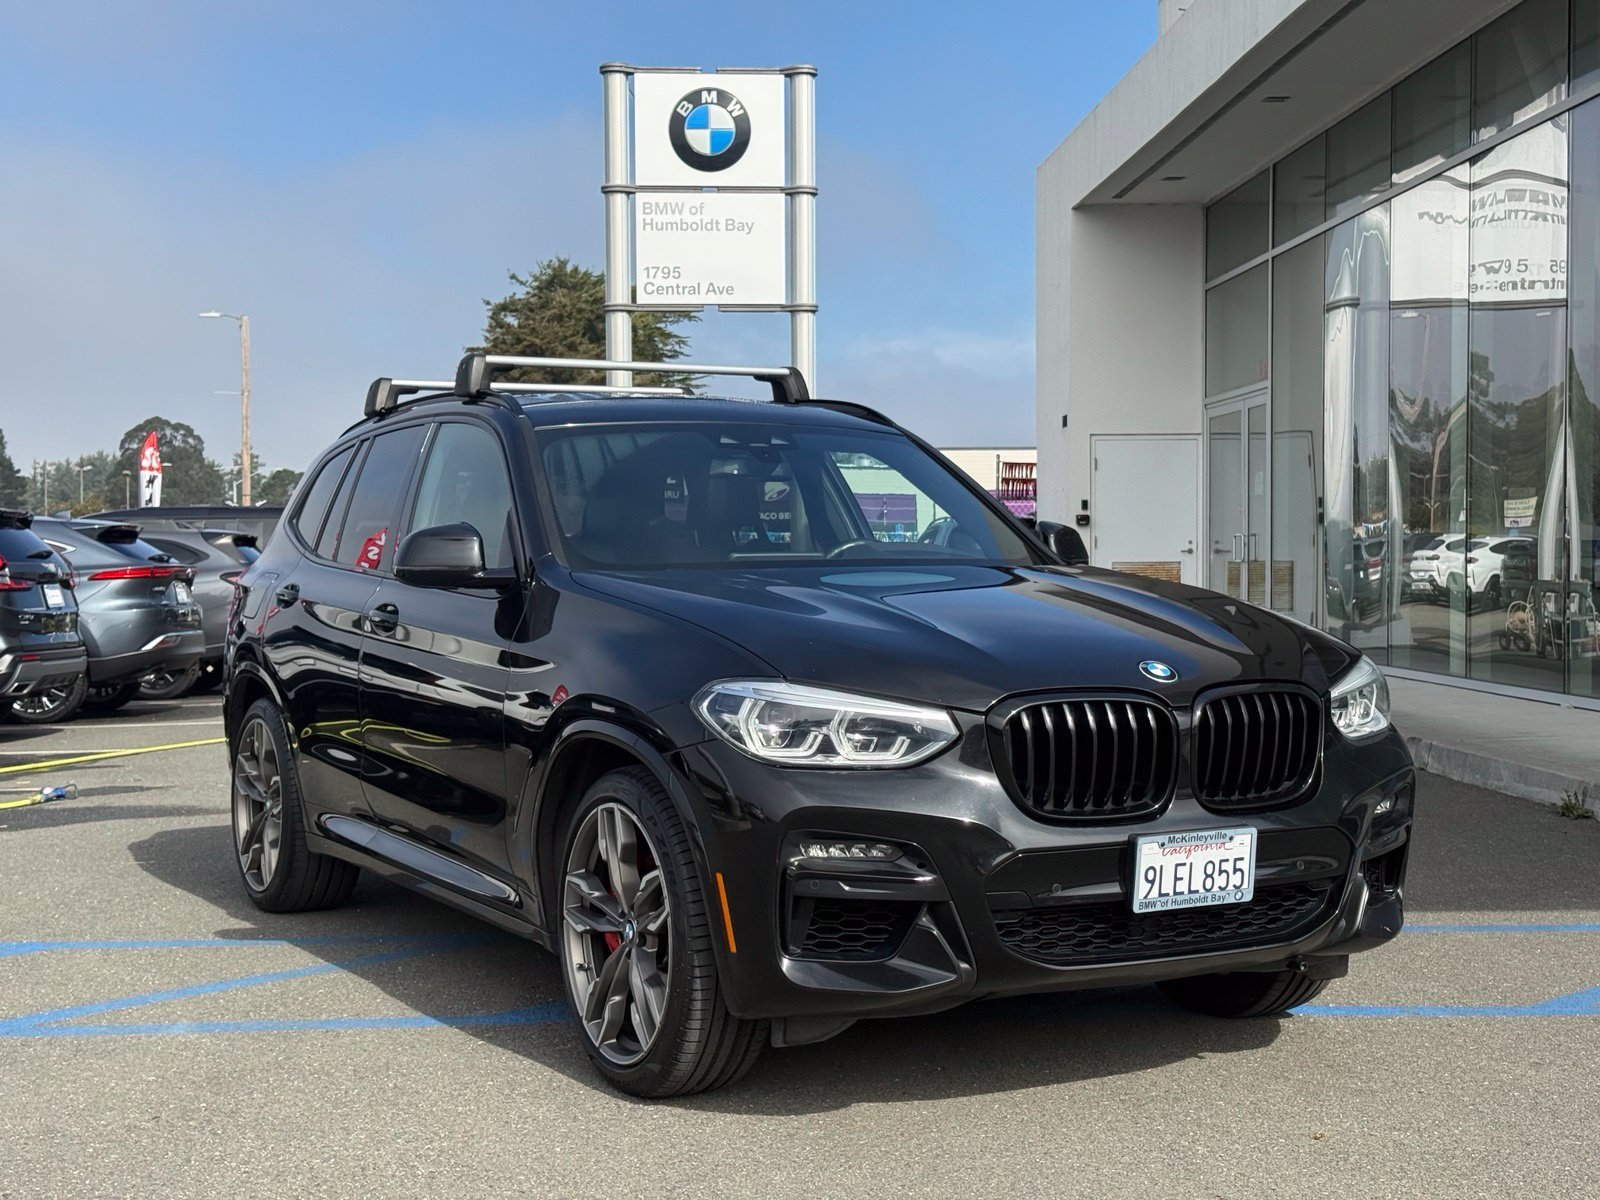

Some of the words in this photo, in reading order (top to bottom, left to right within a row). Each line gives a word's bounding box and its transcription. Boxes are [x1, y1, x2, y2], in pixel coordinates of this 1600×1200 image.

[676, 90, 744, 117] BMW
[642, 202, 684, 216] BMW
[689, 202, 705, 216] of
[642, 218, 720, 232] Humboldt
[725, 219, 754, 235] Bay
[643, 266, 681, 279] 1795
[643, 282, 701, 296] Central
[705, 283, 735, 296] Ave
[758, 512, 777, 520] ACO
[1167, 832, 1228, 845] McKinleyville
[1142, 857, 1245, 899] 9LEL855
[1138, 900, 1158, 911] BMW
[1160, 899, 1169, 908] of
[1170, 896, 1209, 907] Humboldt
[1210, 893, 1227, 904] Bay
